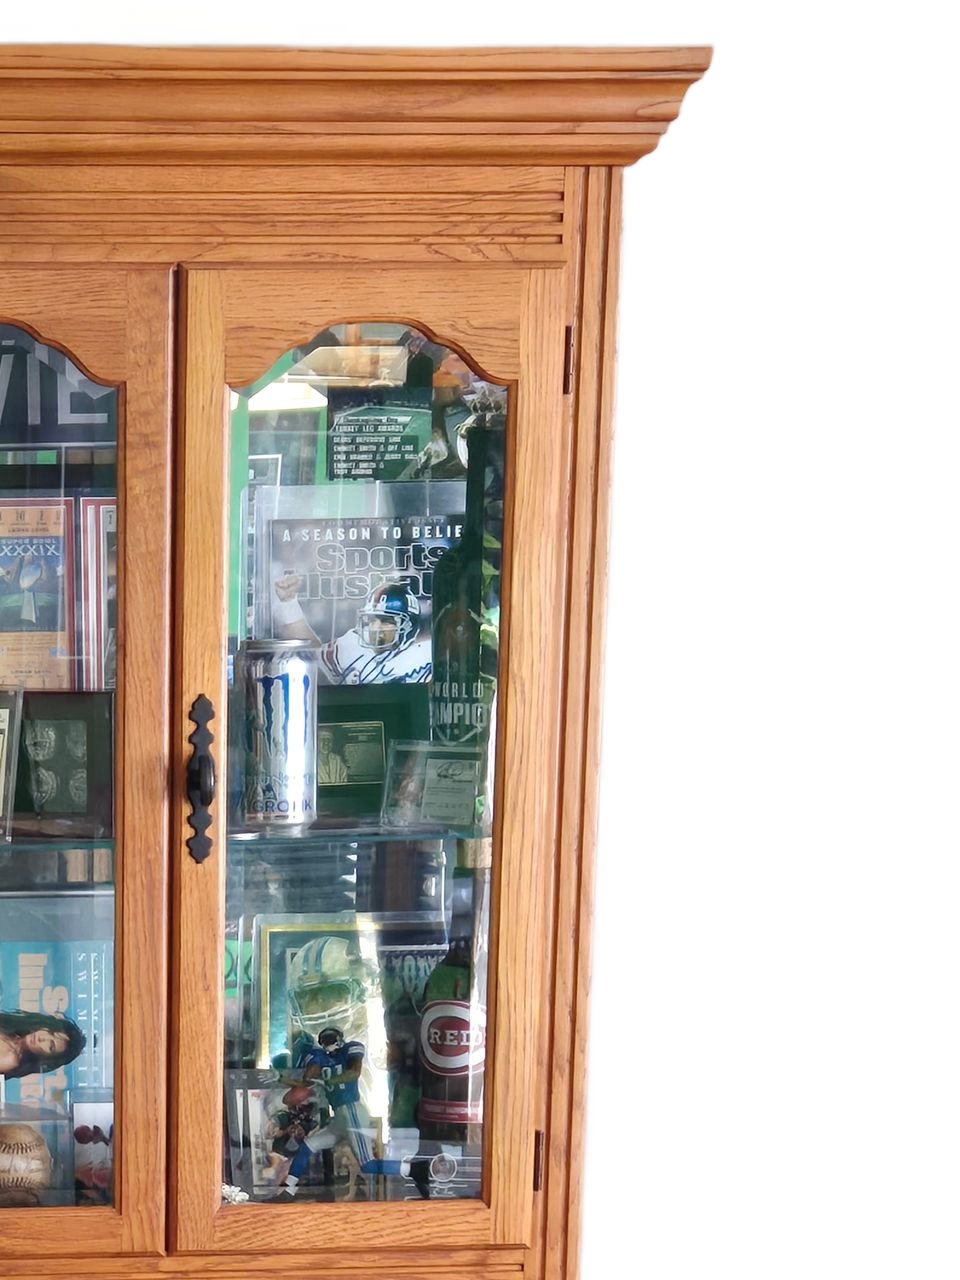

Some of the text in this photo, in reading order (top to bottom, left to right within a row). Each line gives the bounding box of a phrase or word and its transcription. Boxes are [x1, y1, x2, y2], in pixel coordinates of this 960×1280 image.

[282, 525, 463, 542] A SEASON TO BELIE
[0, 544, 61, 556] XXXIX
